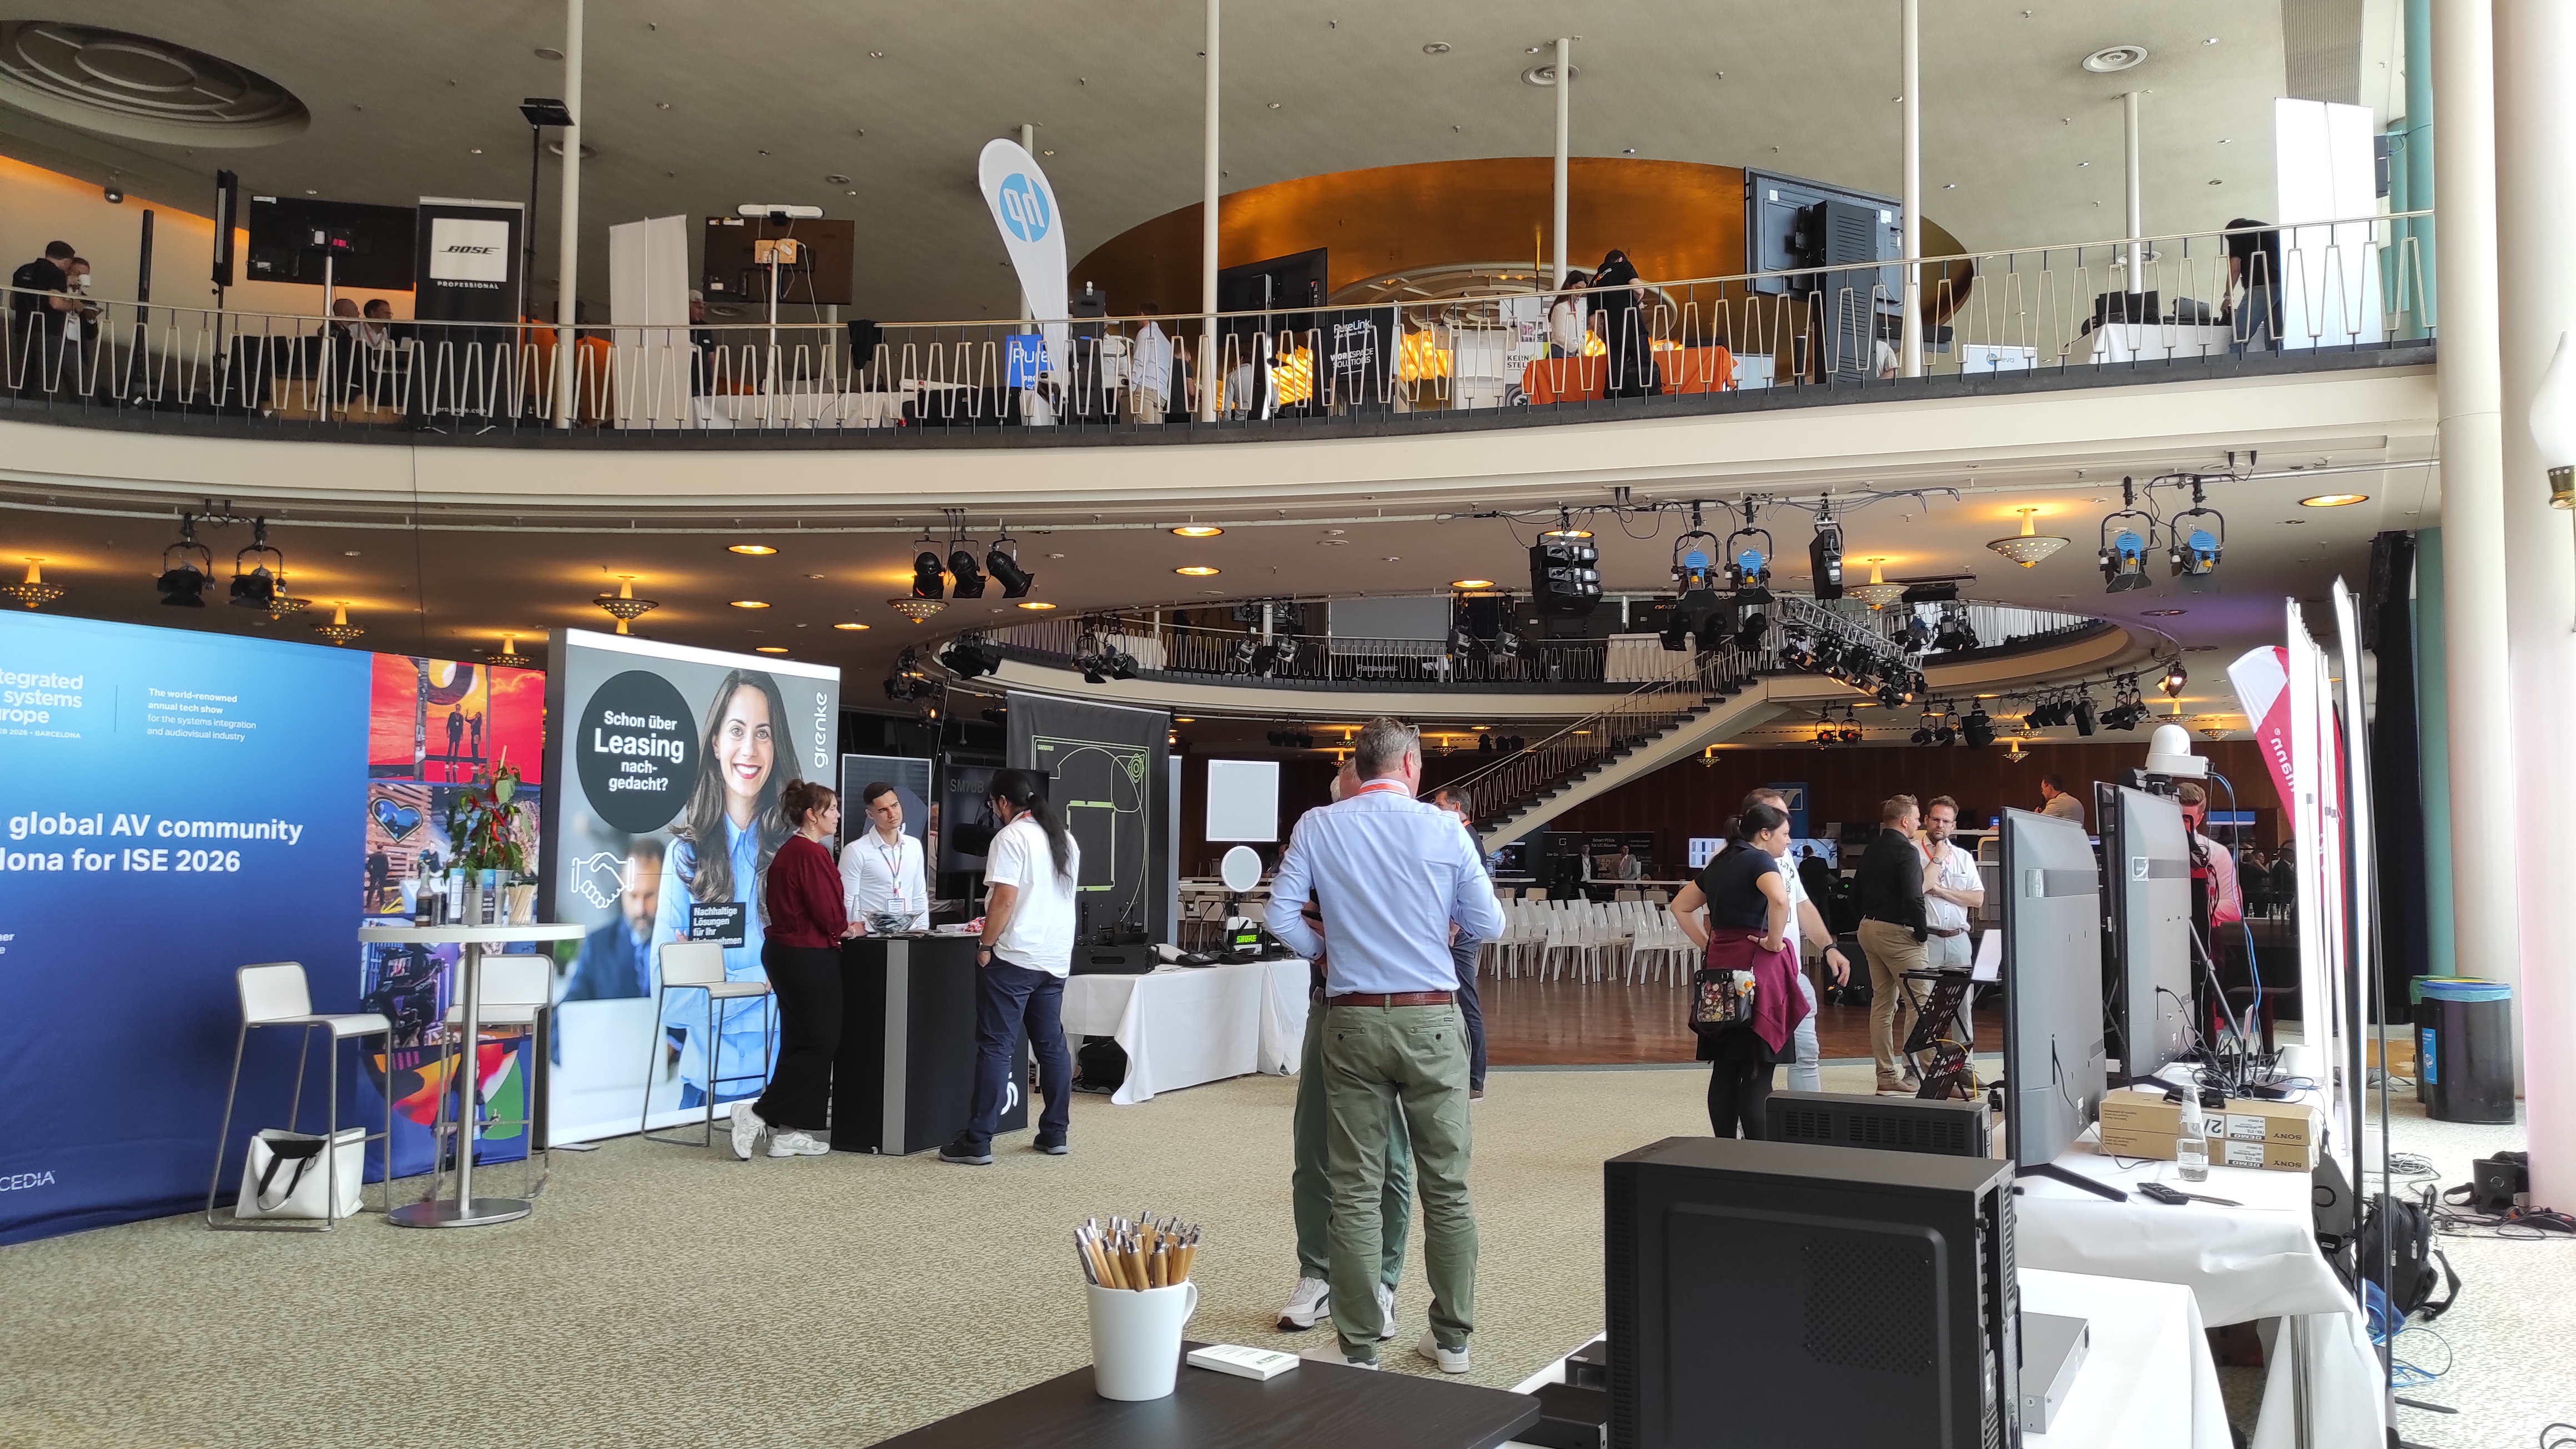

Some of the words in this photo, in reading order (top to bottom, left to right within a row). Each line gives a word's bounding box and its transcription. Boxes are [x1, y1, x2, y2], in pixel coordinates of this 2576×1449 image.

[439, 246, 500, 255] BOSE
[437, 280, 500, 289] PROFESSIONAL
[4, 690, 83, 708] systems
[149, 687, 165, 697] The
[168, 691, 238, 703] world-renowned
[179, 703, 199, 712] tech
[200, 706, 223, 714] show
[162, 715, 175, 723] the
[177, 717, 212, 726] systems
[214, 718, 256, 729] integration
[604, 710, 645, 727] Schon
[648, 715, 678, 730] über
[36, 730, 81, 739] BARCELONA
[165, 729, 212, 738] audiovisual
[213, 731, 245, 742] industry
[814, 692, 829, 768] grenke
[594, 727, 684, 764] Leasing
[621, 759, 658, 773] nach-
[608, 775, 668, 792] gedacht?
[9, 811, 104, 840] global
[111, 814, 151, 837] AV
[157, 818, 303, 846] community
[72, 848, 115, 871] for
[123, 848, 169, 872] ISE
[175, 849, 241, 872] 2026
[693, 906, 738, 917] Nachhaltige
[693, 917, 730, 927] Lösungen
[693, 928, 705, 936] für
[705, 927, 716, 935] Ihr
[1236, 935, 1257, 943] SHURE
[0, 1171, 56, 1191] CEDIA
